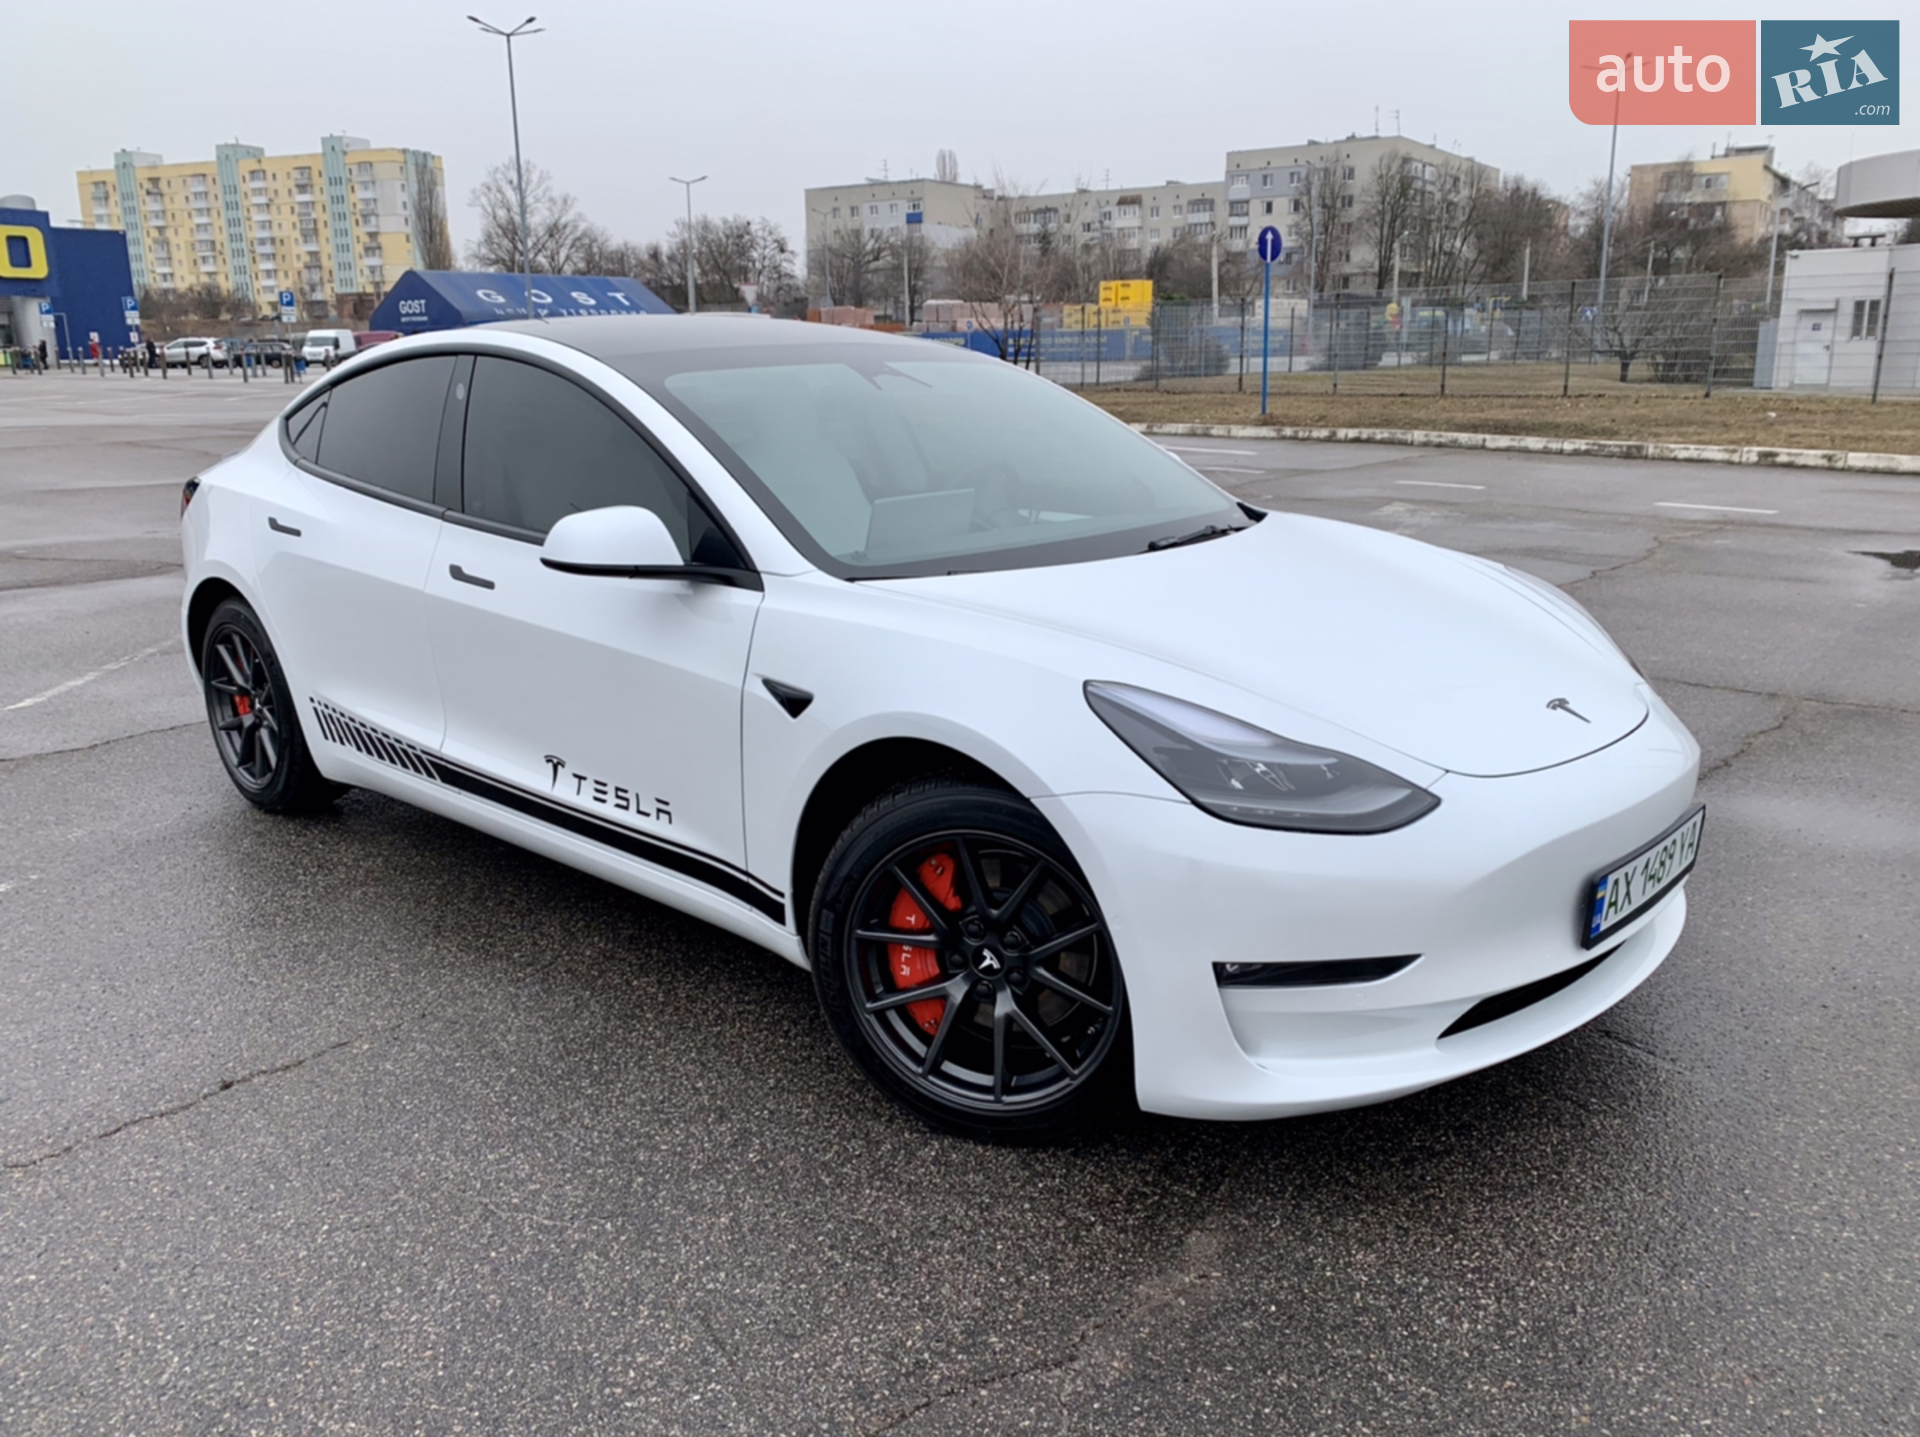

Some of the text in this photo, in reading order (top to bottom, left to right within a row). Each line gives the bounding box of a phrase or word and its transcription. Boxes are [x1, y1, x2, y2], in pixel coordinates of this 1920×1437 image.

[399, 299, 427, 314] GOST
[476, 288, 631, 306] GOST
[571, 772, 673, 825] TESLA
[1603, 865, 1638, 921] AX
[1640, 838, 1677, 896] 1489
[900, 913, 916, 977] TSLA
